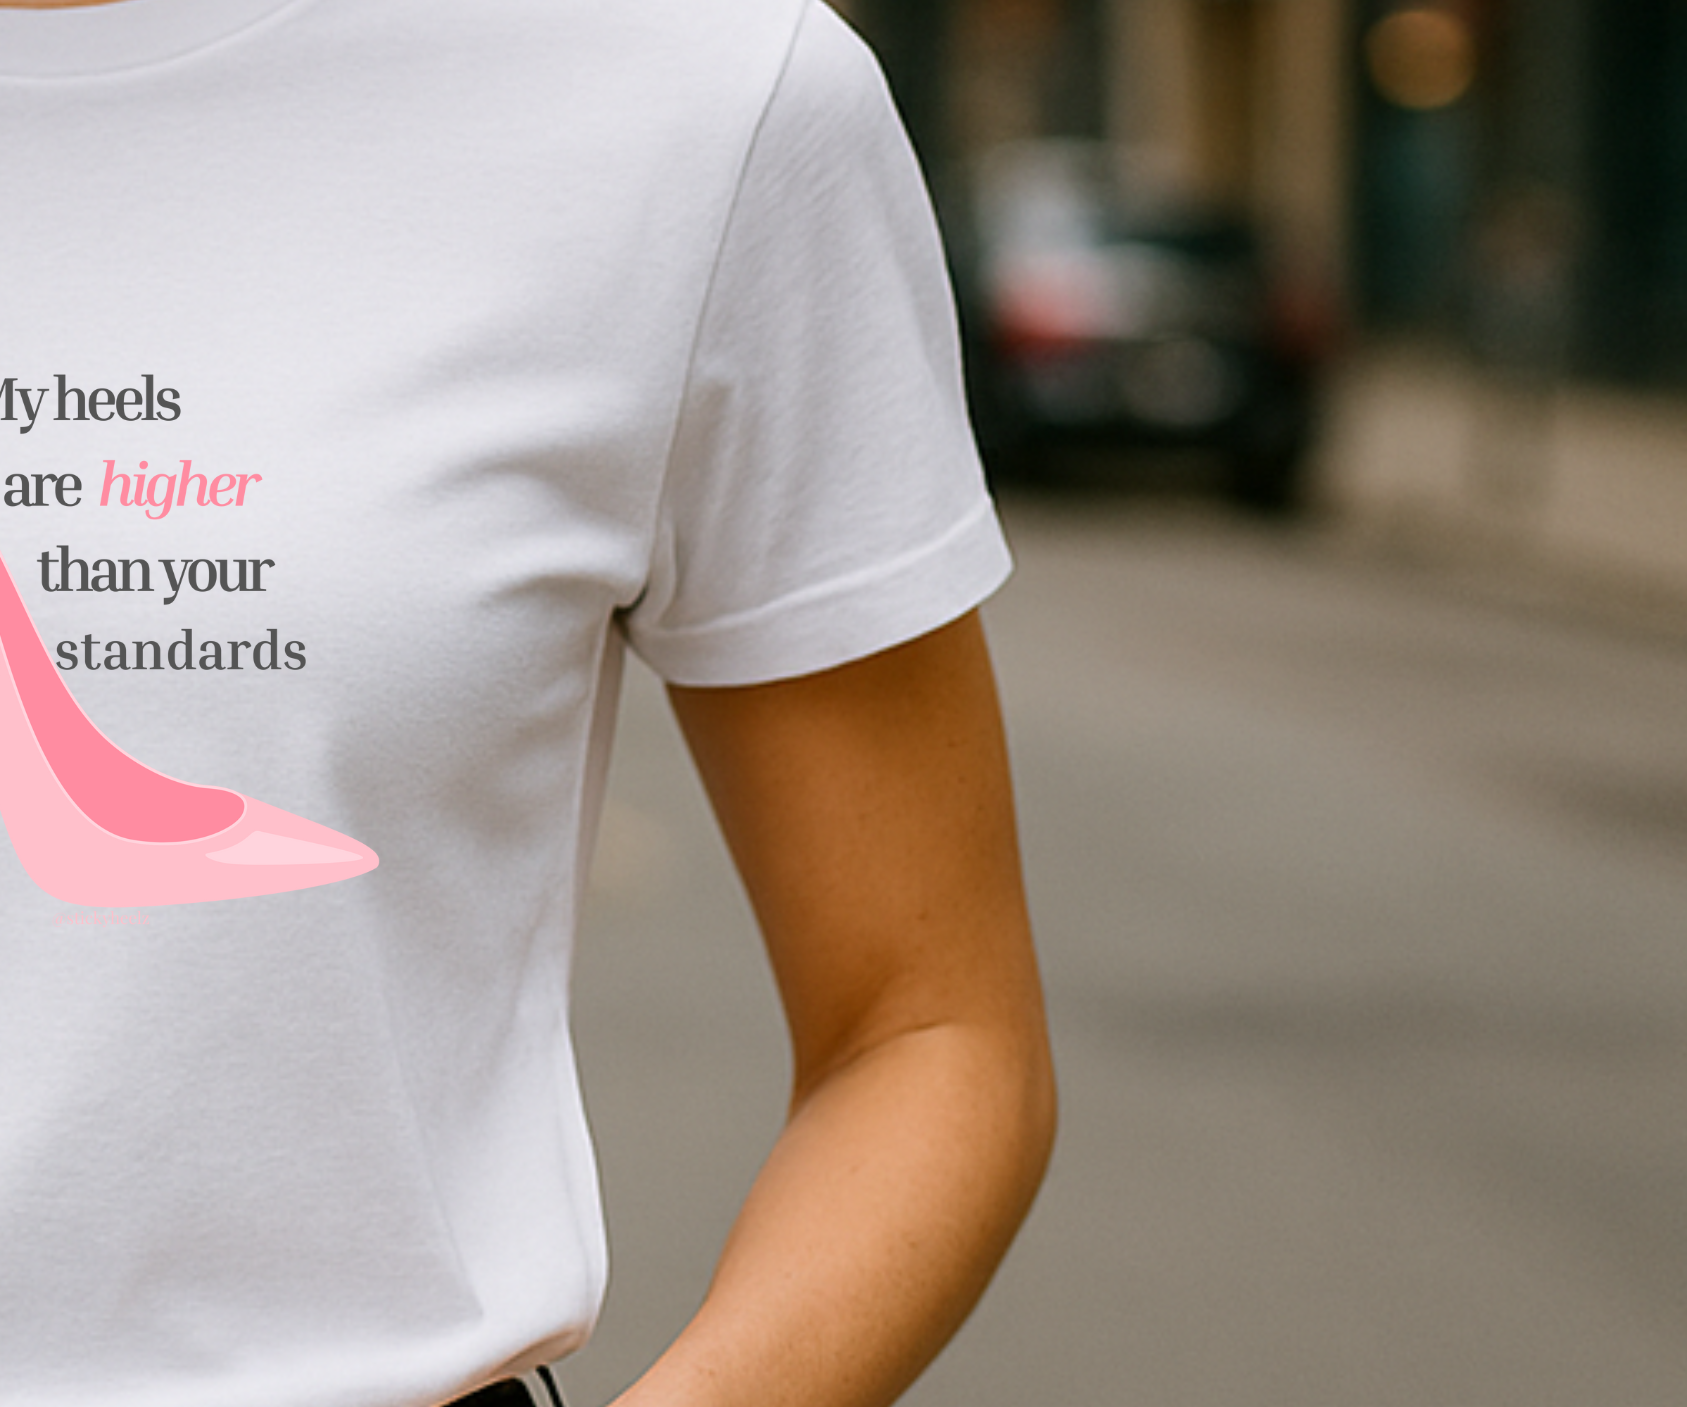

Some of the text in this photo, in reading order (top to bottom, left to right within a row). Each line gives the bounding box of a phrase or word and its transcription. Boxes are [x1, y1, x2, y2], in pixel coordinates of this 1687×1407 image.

[53, 374, 182, 422] heels
[3, 459, 263, 520] are higher
[36, 544, 276, 606] than your
[55, 628, 307, 671] standards
[52, 910, 150, 928] @stickyheelz
